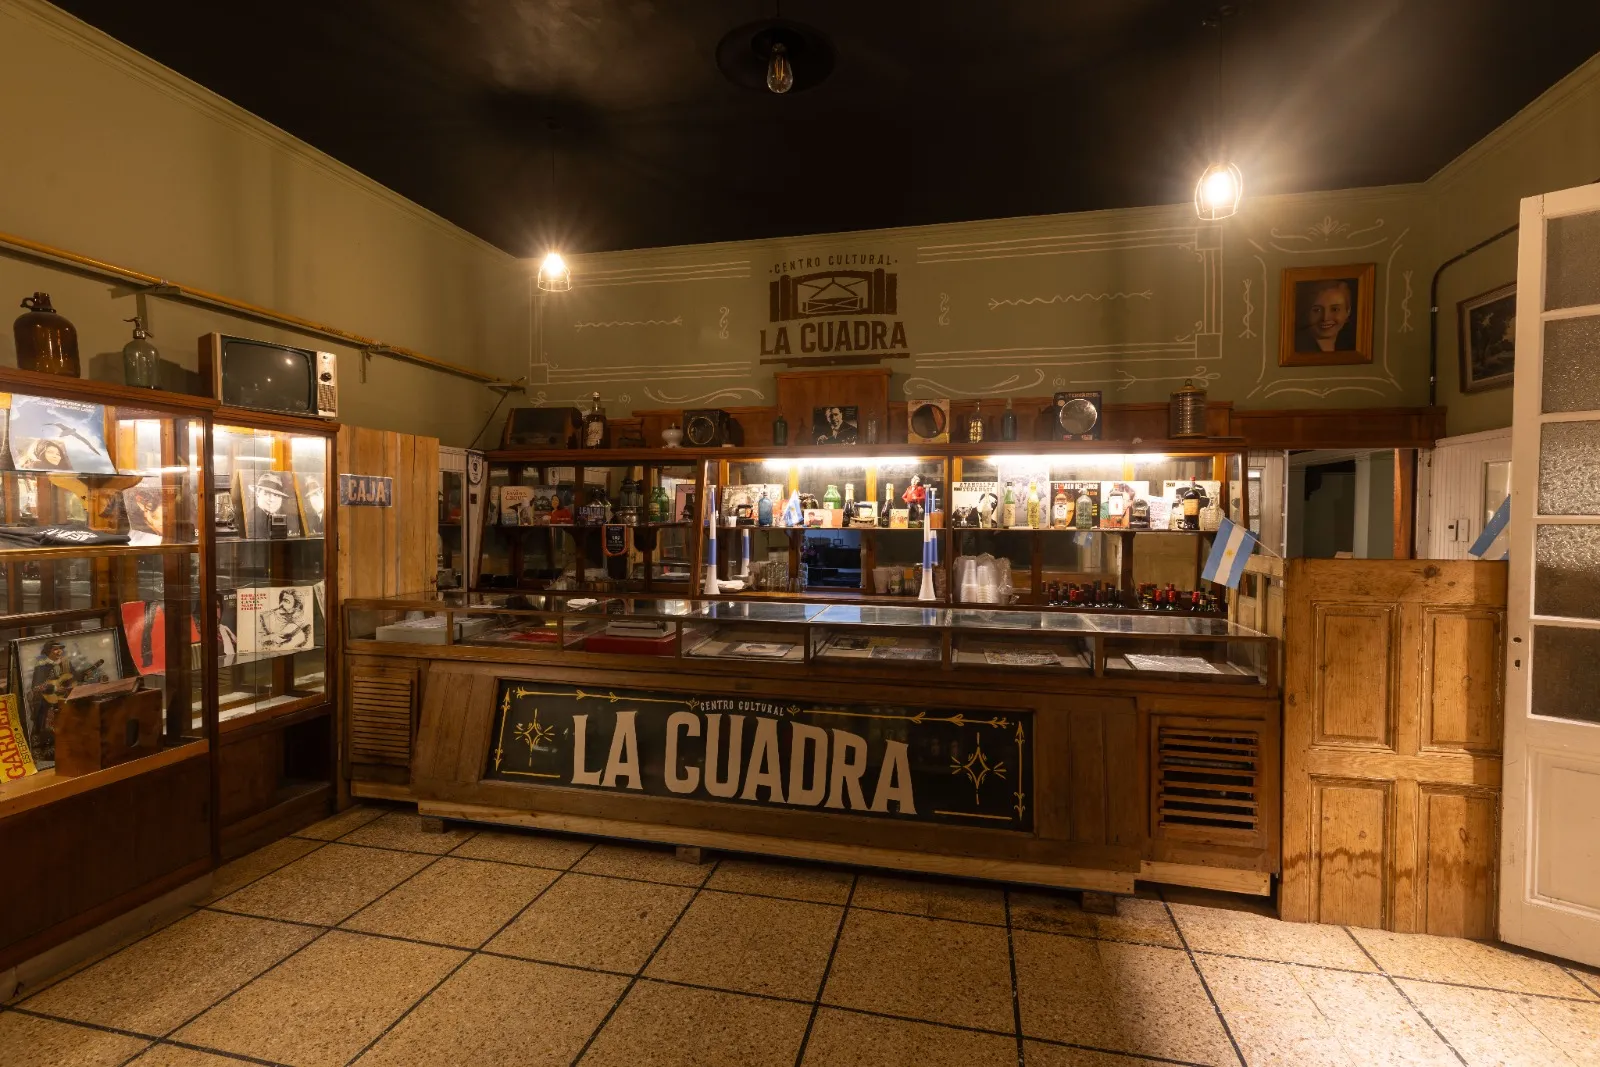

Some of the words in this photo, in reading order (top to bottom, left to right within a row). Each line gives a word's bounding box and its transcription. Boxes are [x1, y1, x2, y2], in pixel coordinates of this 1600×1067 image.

[774, 257, 820, 273] CENTRO
[828, 254, 891, 266] CULTURAL
[760, 327, 791, 356] LA
[801, 320, 908, 354] CUADRA
[348, 479, 386, 502] CAJA
[700, 699, 734, 711] CENTRO
[738, 701, 784, 716] CULTURAL
[571, 710, 643, 790] LA
[664, 711, 918, 815] CUADRA
